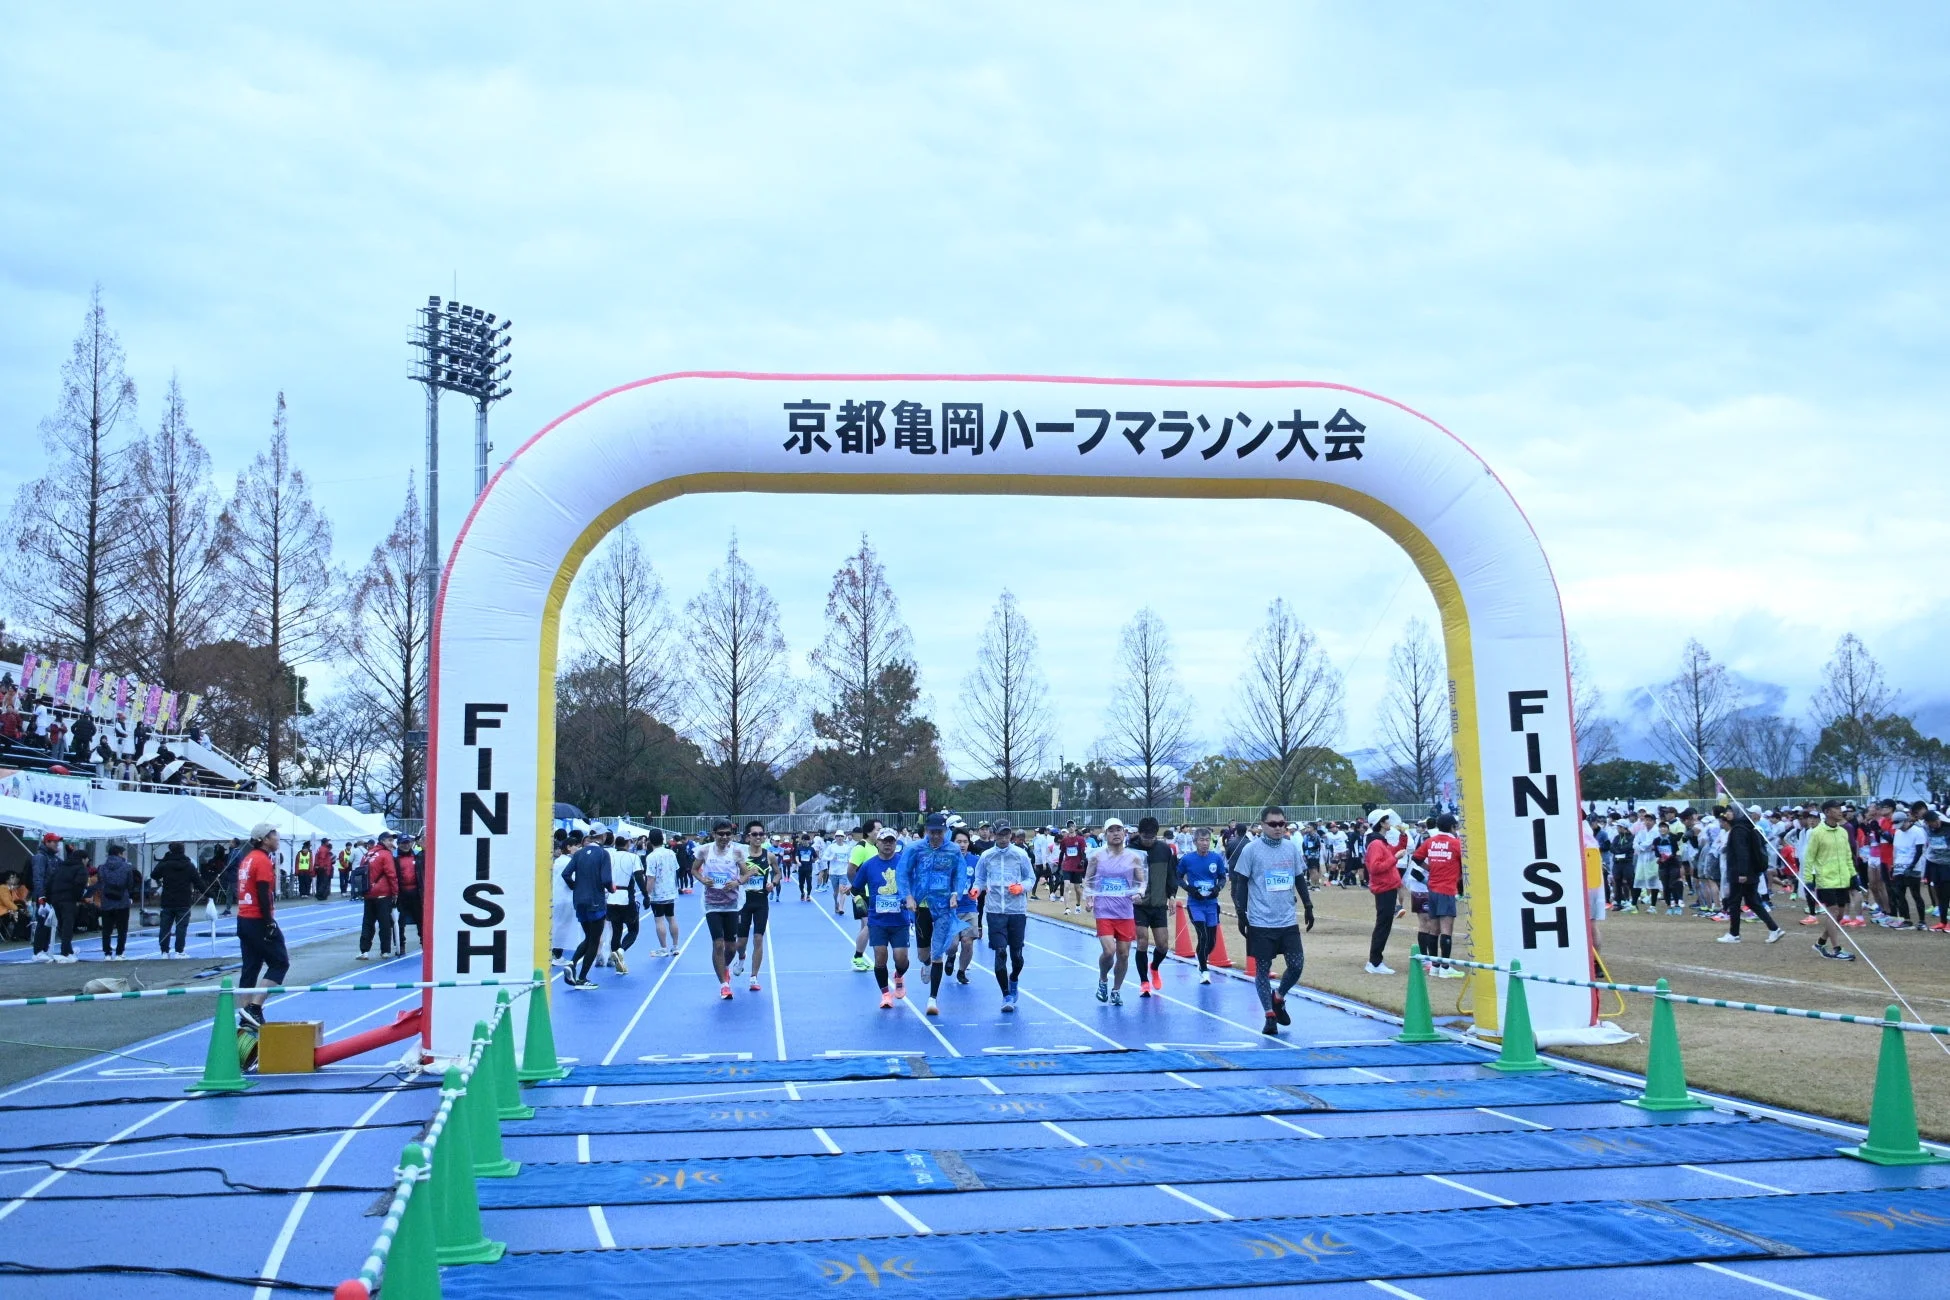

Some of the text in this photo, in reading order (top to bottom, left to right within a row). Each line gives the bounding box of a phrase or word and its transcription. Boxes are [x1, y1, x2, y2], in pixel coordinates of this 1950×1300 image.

[782, 399, 1367, 462] 京都亀岡ハーフマラソン大会
[456, 703, 509, 974] FINISH
[1430, 841, 1449, 850] Patrol
[1508, 689, 1570, 950] FINISH
[1273, 877, 1290, 885] 1667
